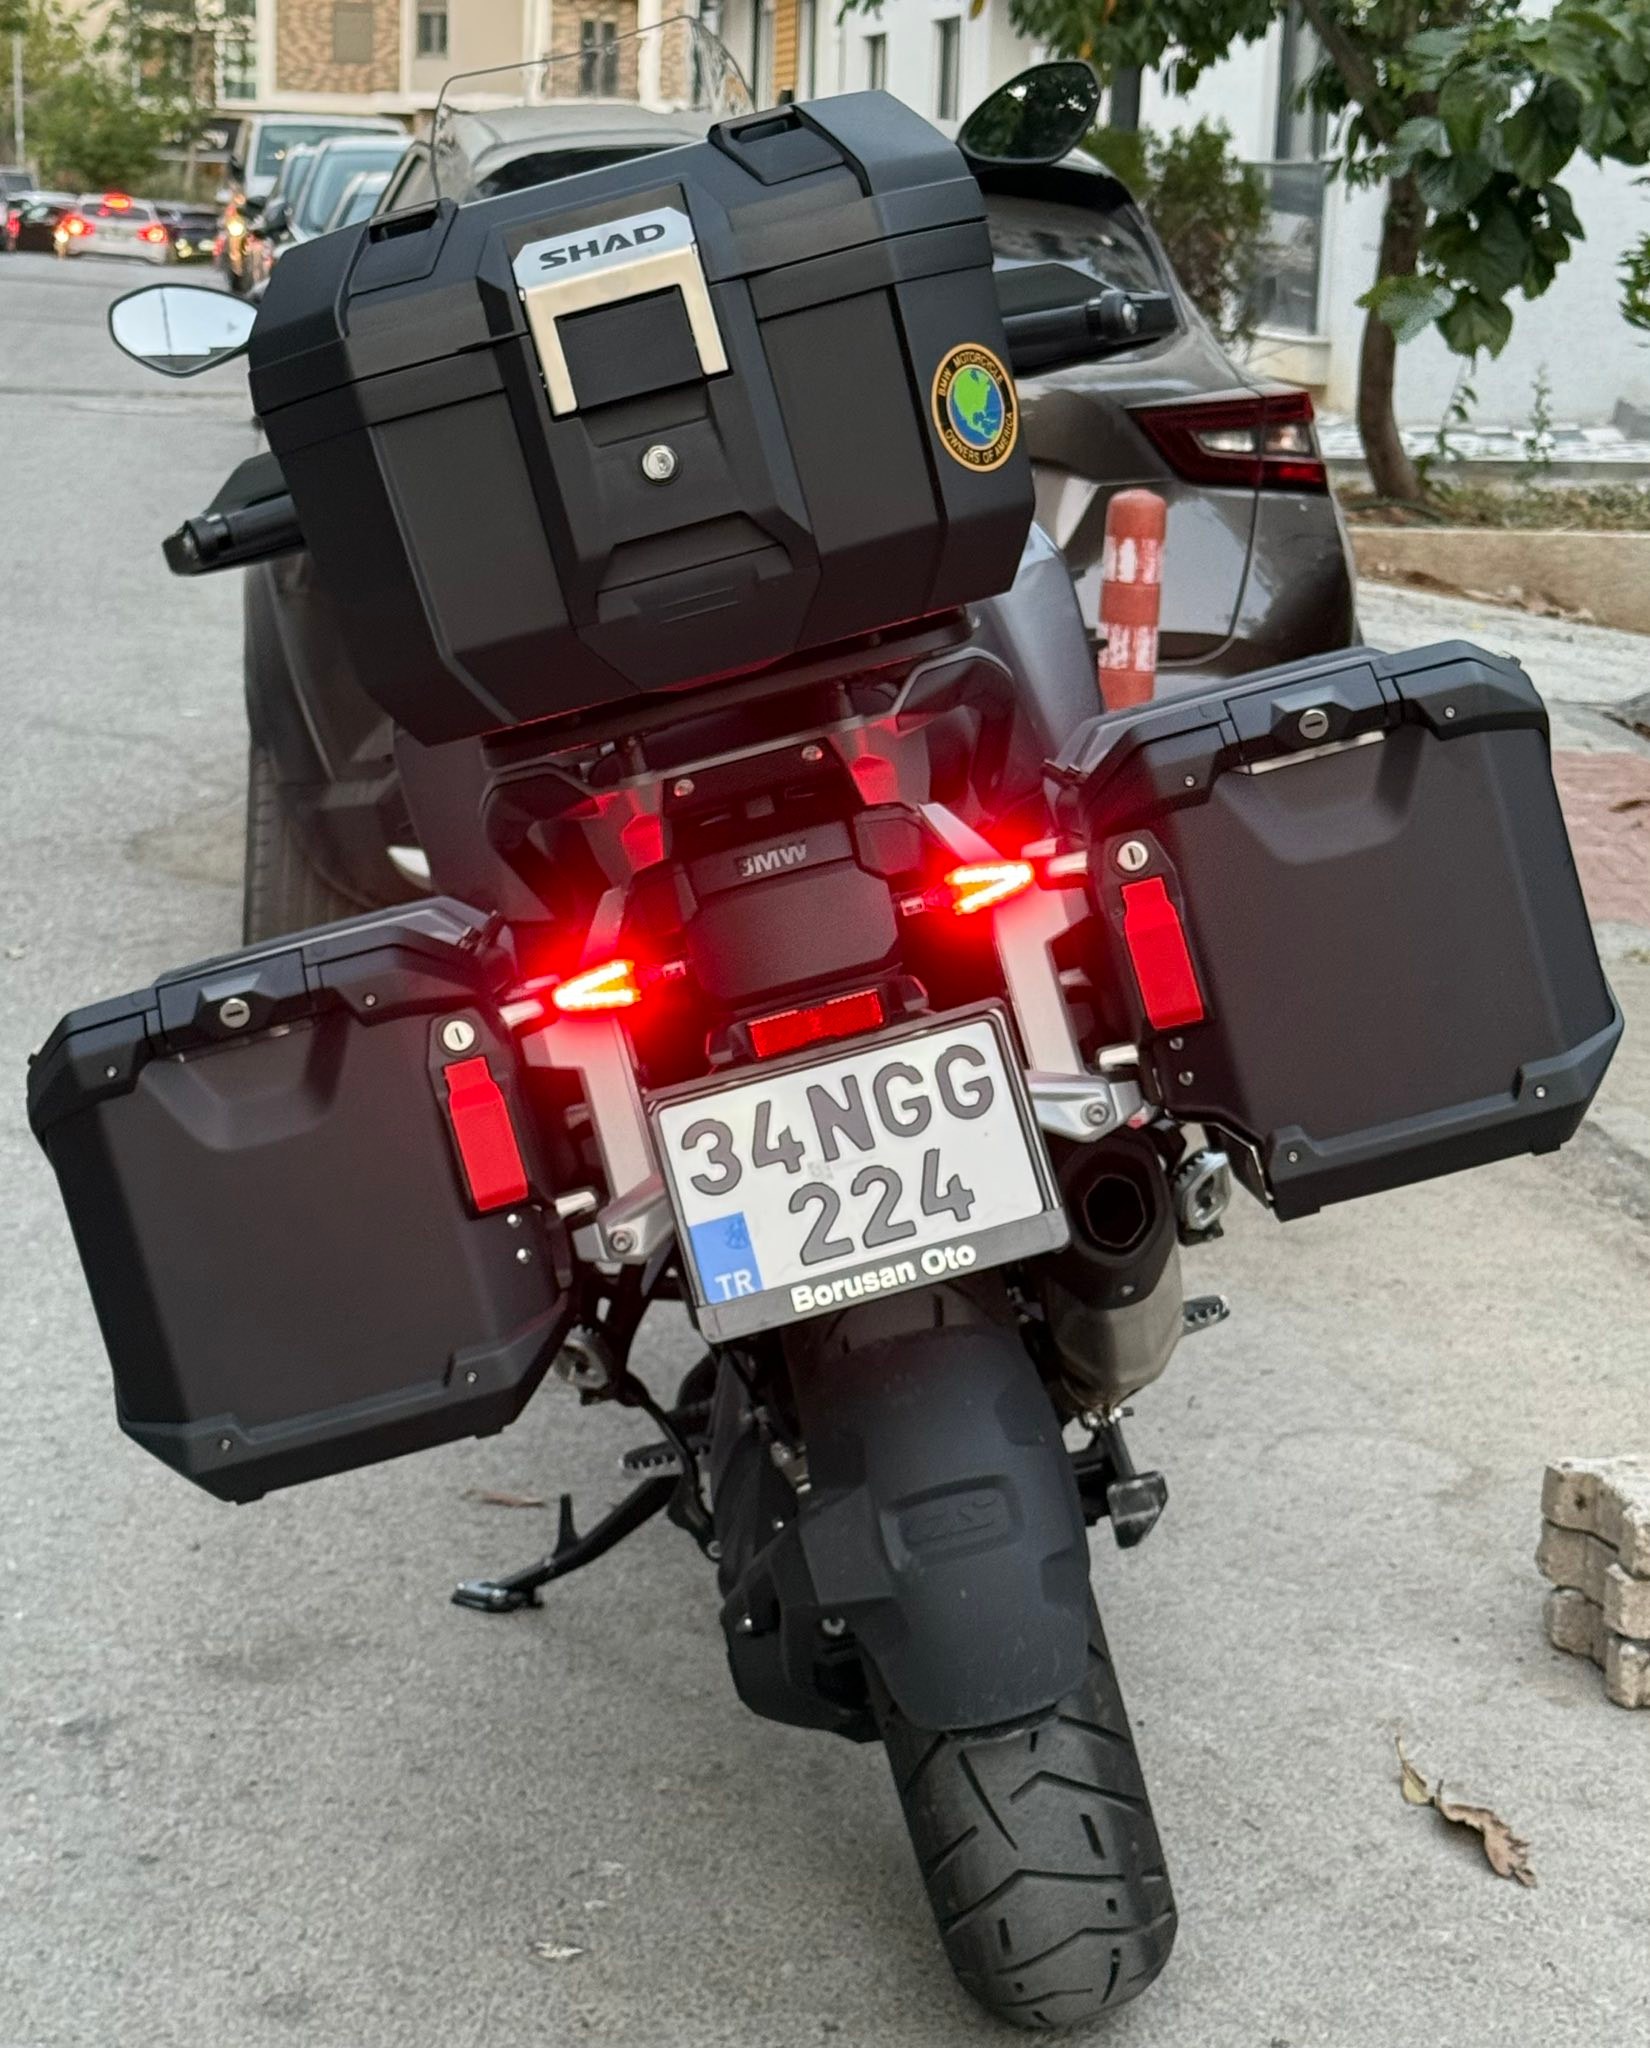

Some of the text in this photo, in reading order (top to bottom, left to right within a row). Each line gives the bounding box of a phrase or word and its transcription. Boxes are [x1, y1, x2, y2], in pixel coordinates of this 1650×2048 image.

[538, 223, 666, 271] SHAD
[938, 352, 1003, 397] BMW MOTORCYCLE
[944, 412, 1013, 464] OWNERS OF AMERICA
[788, 1148, 976, 1267] 224
[714, 1267, 756, 1301] TR
[790, 1243, 977, 1314] Borusan Oto
